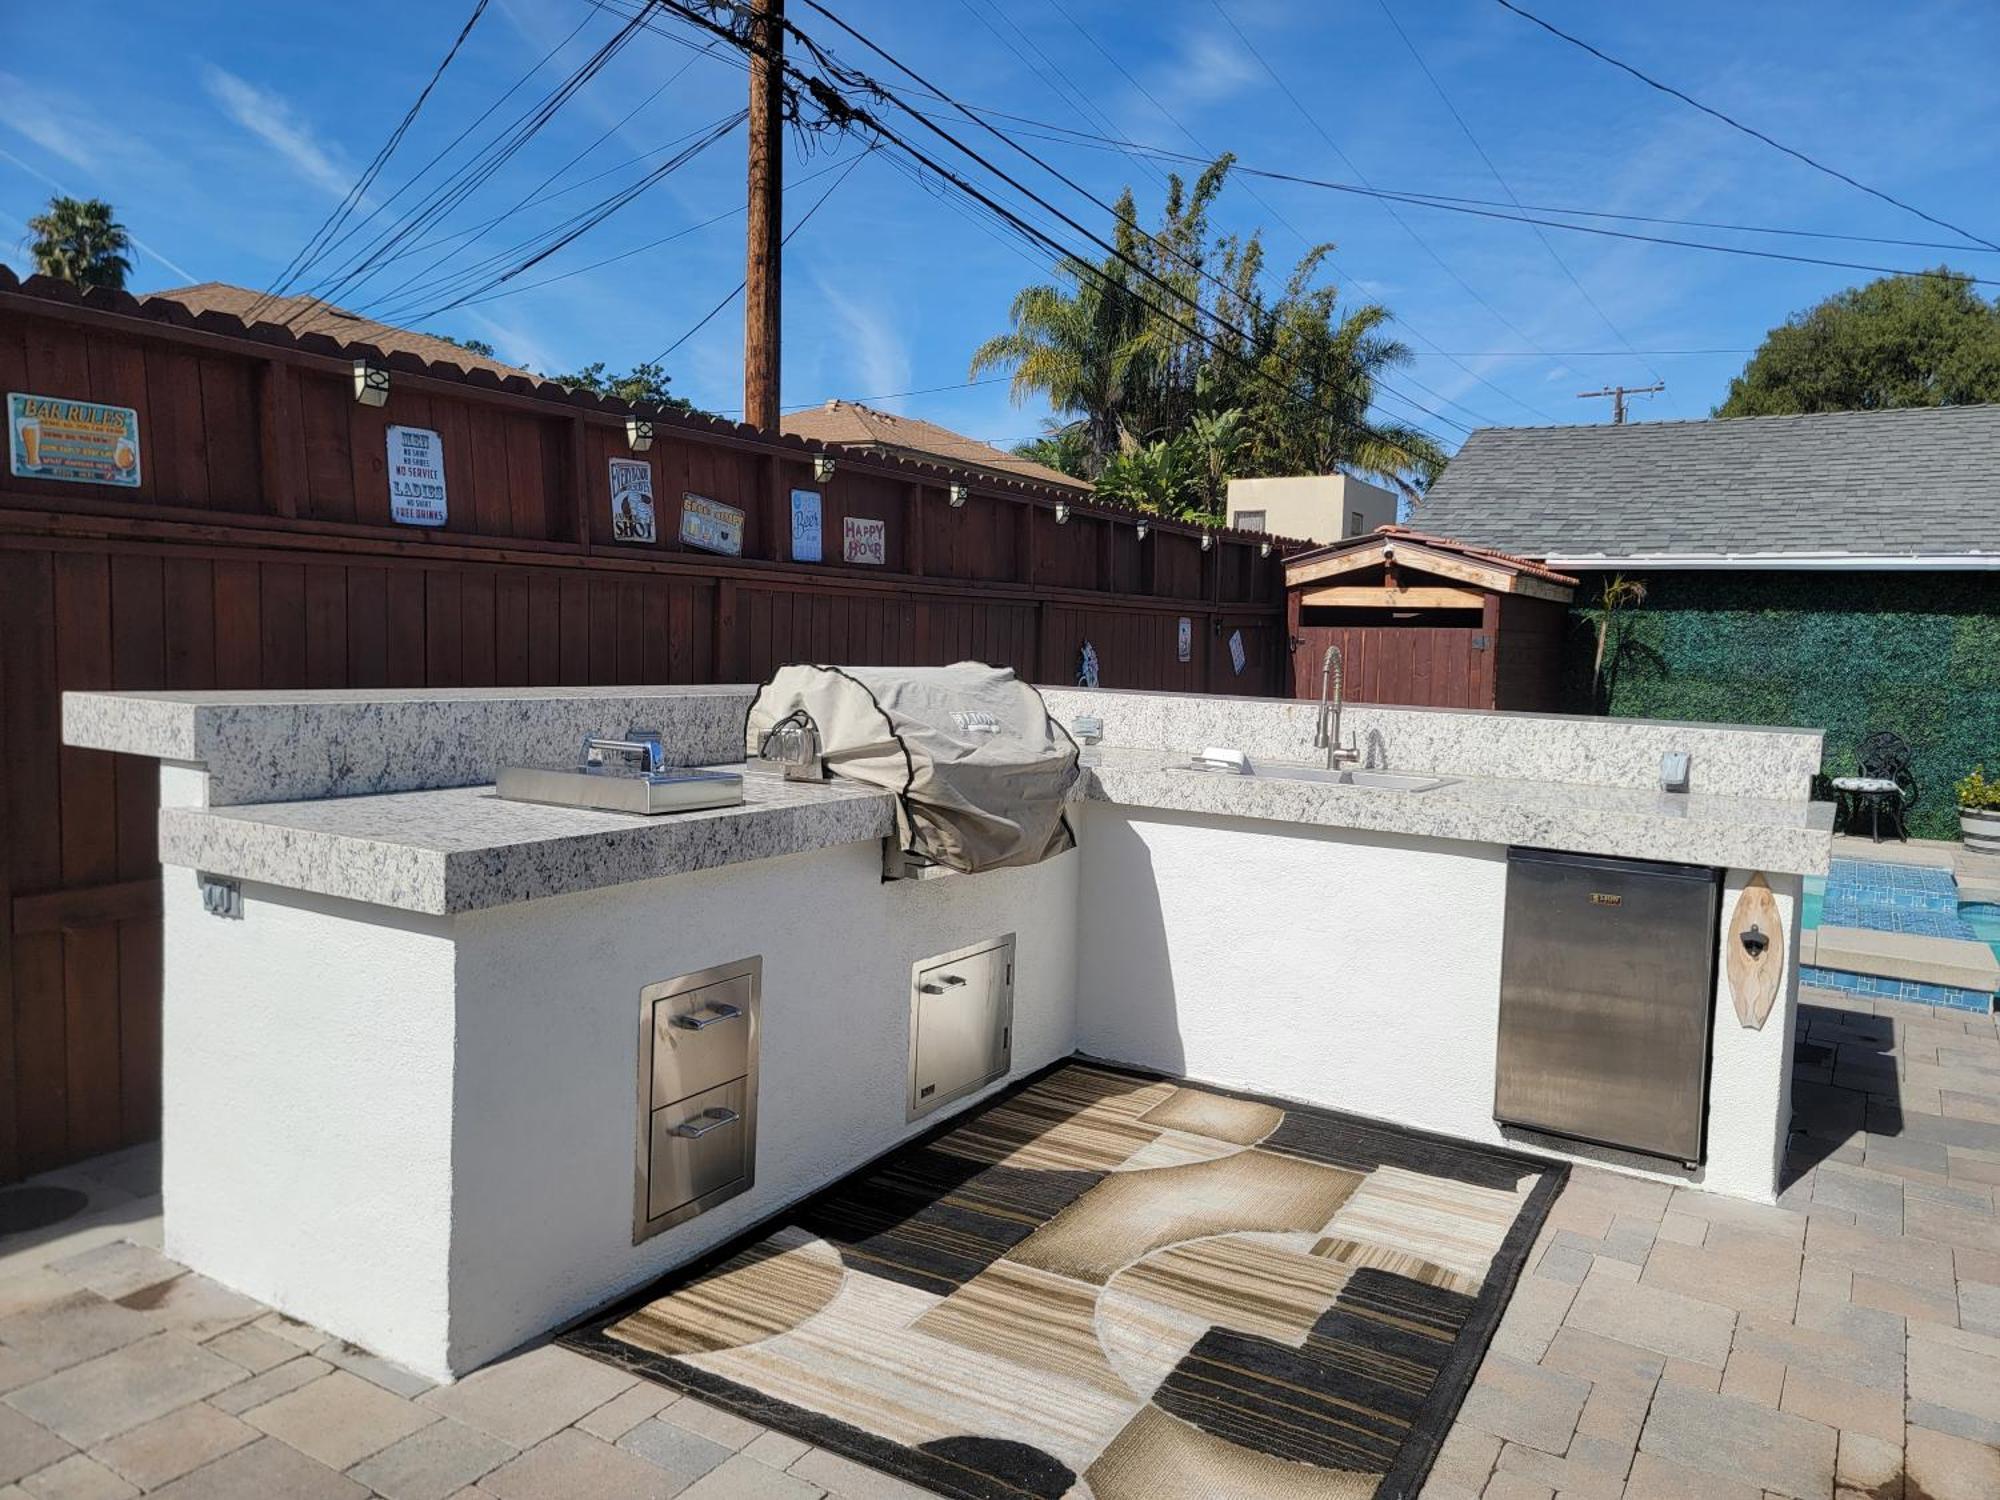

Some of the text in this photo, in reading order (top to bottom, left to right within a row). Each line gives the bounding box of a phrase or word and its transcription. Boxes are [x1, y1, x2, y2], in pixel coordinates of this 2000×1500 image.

[25, 399, 62, 419] BAR
[67, 406, 125, 428] RULES
[396, 465, 438, 480] NO SERVICE
[393, 481, 444, 501] LADIES
[395, 507, 444, 521] FREE DRINKS
[615, 520, 652, 538] SHOT
[794, 511, 818, 539] Beer
[844, 519, 883, 540] HAPPY
[846, 541, 883, 561] HOUR
